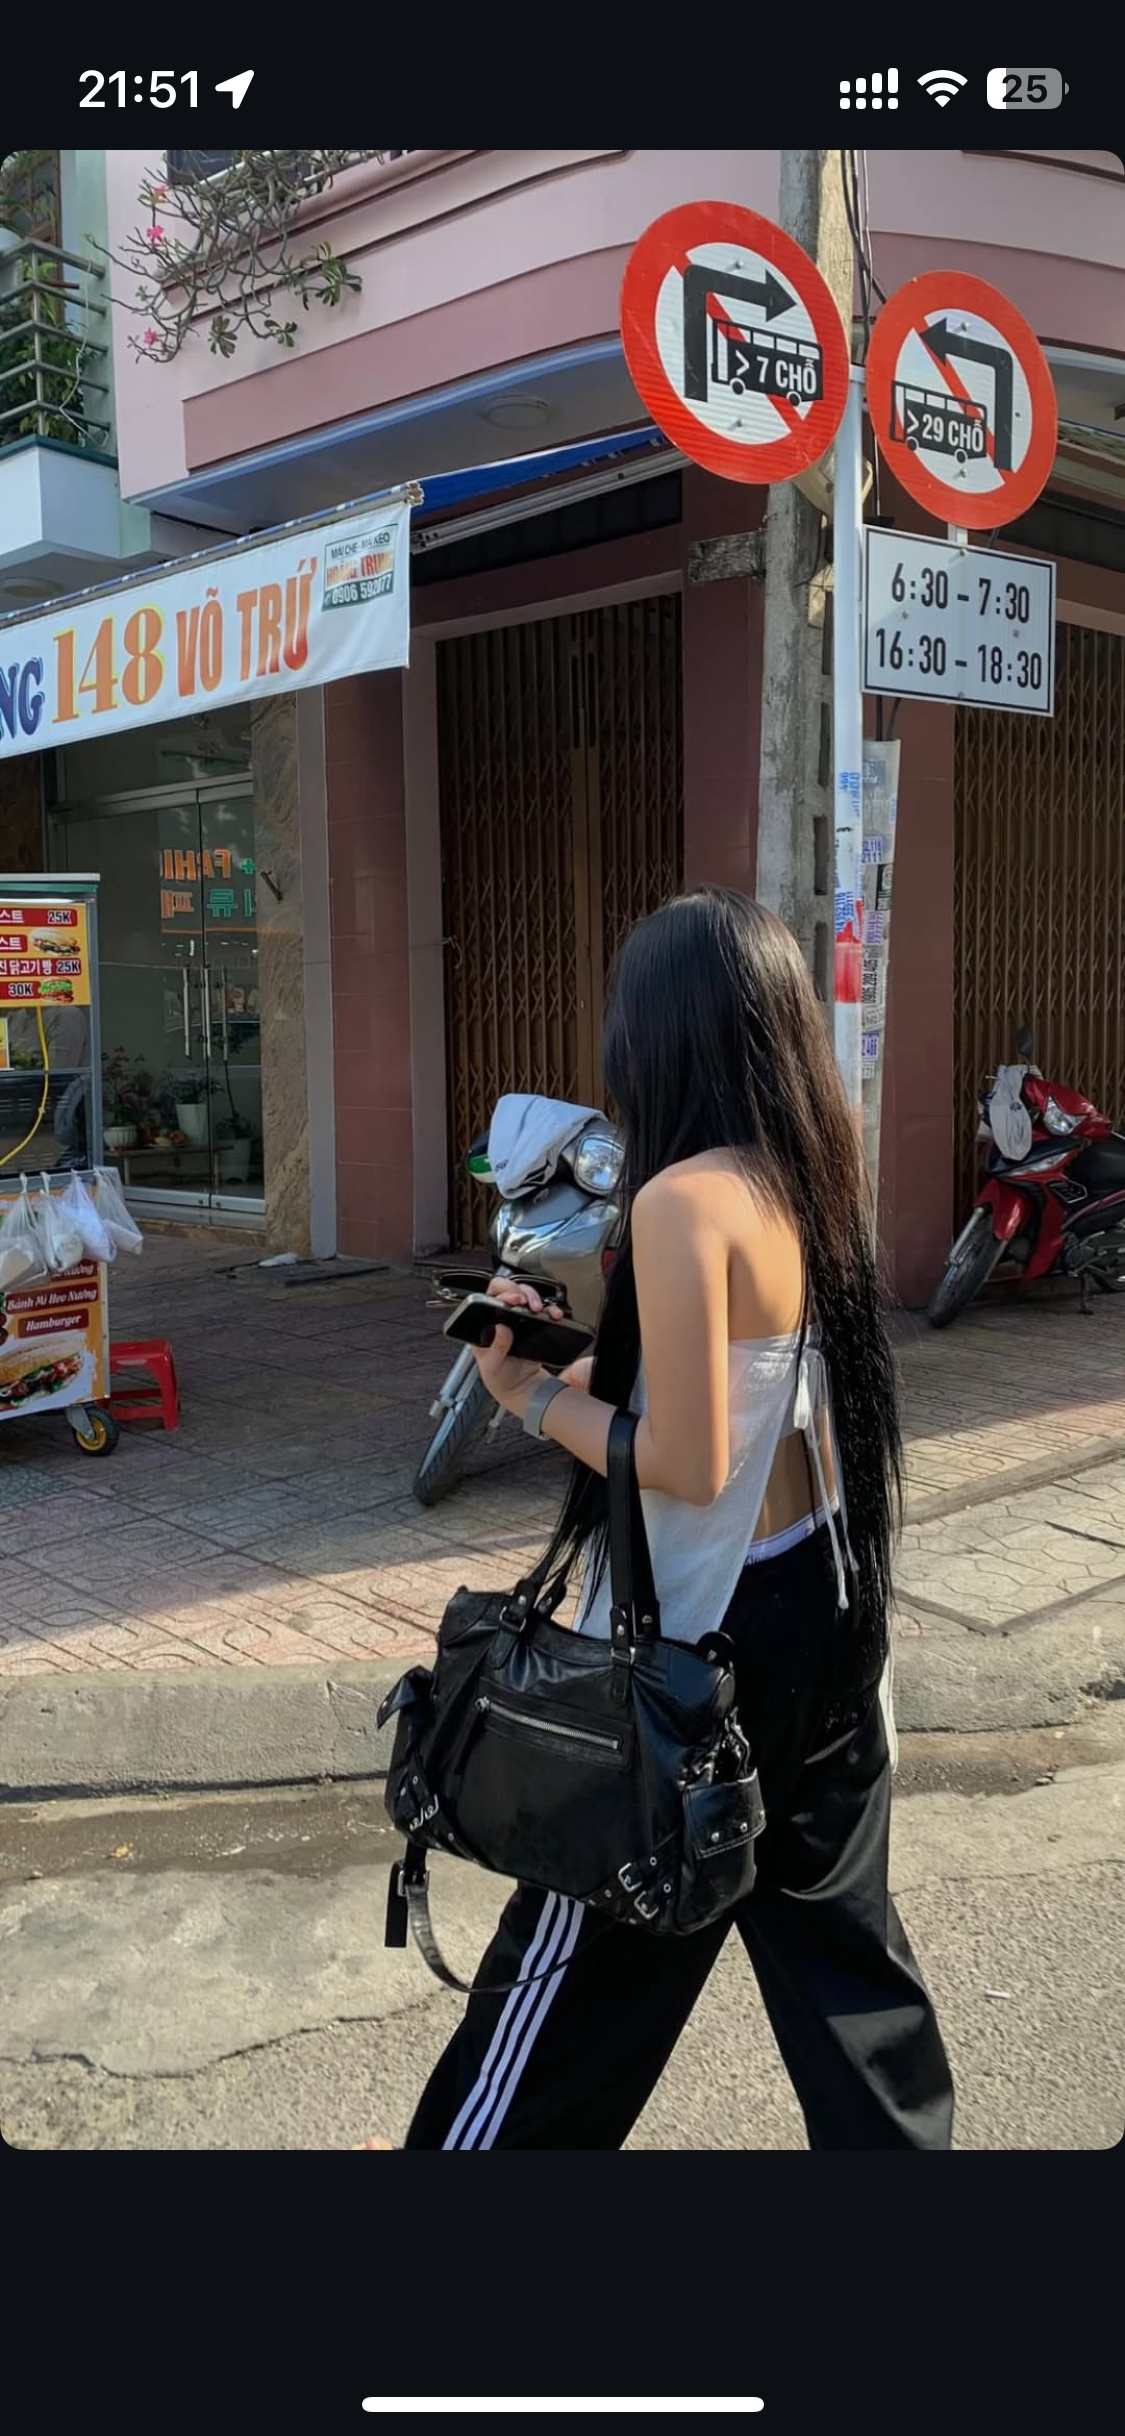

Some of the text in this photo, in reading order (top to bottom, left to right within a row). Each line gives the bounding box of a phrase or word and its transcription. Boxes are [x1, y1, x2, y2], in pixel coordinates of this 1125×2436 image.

[756, 355, 769, 383] 7
[775, 358, 817, 394] CHỖ
[922, 413, 944, 442] 29
[948, 419, 984, 452] CHỖ
[891, 563, 948, 609] 6:30
[978, 577, 1030, 624] 7:30
[51, 602, 166, 724] 148
[176, 585, 223, 697] VÕ
[236, 556, 318, 682] TRỨ
[876, 628, 947, 676] 16:30
[977, 644, 1042, 690] 18:30
[47, 910, 73, 925] 25K
[56, 959, 81, 974] 25K
[8, 983, 34, 996] 30K
[26, 1315, 82, 1331] Hamburger
